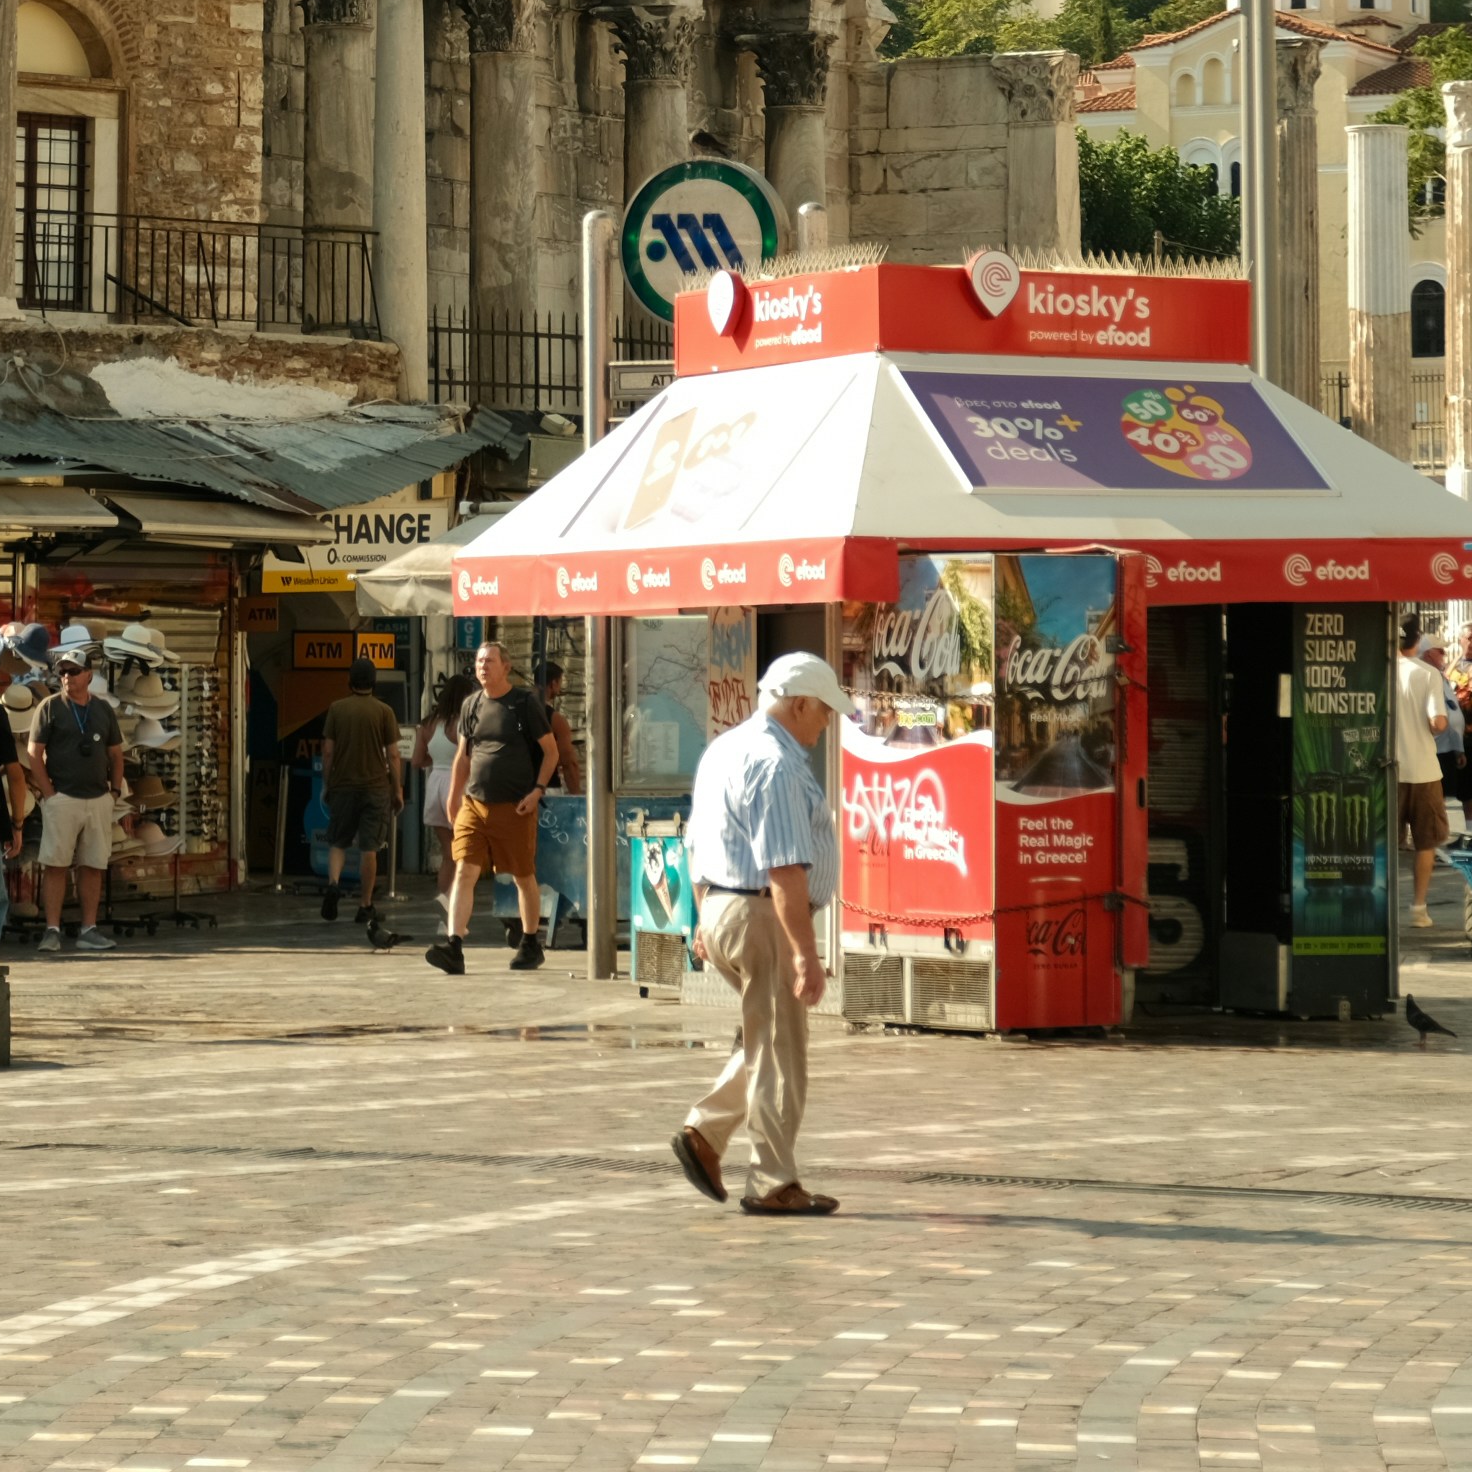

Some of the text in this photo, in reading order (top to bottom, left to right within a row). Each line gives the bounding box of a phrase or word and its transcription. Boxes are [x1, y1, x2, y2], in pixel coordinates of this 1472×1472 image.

[754, 285, 822, 322] kiosky's
[1029, 282, 1150, 322] kiosky's
[755, 322, 822, 348] powered by efood
[1029, 324, 1150, 347] powered by efood
[1020, 399, 1062, 410] efood
[1126, 427, 1198, 454] 40%
[987, 442, 1077, 463] deals
[342, 554, 386, 562] COMMISSION
[472, 558, 826, 596] efood efood efood efood efood
[1167, 561, 1222, 582] efood
[1315, 560, 1369, 580] efood
[248, 608, 276, 621] ATM
[1305, 613, 1344, 636] ZERO
[305, 642, 343, 659] ATM
[359, 642, 394, 660] ATM
[1305, 640, 1356, 662] SUGAR
[1305, 666, 1346, 688] 100%
[1304, 692, 1376, 714] MONSTER
[296, 739, 324, 758] AT
[1019, 817, 1073, 830] Feel the
[1019, 834, 1093, 848] Real Magic
[1019, 851, 1087, 865] in Greece!
